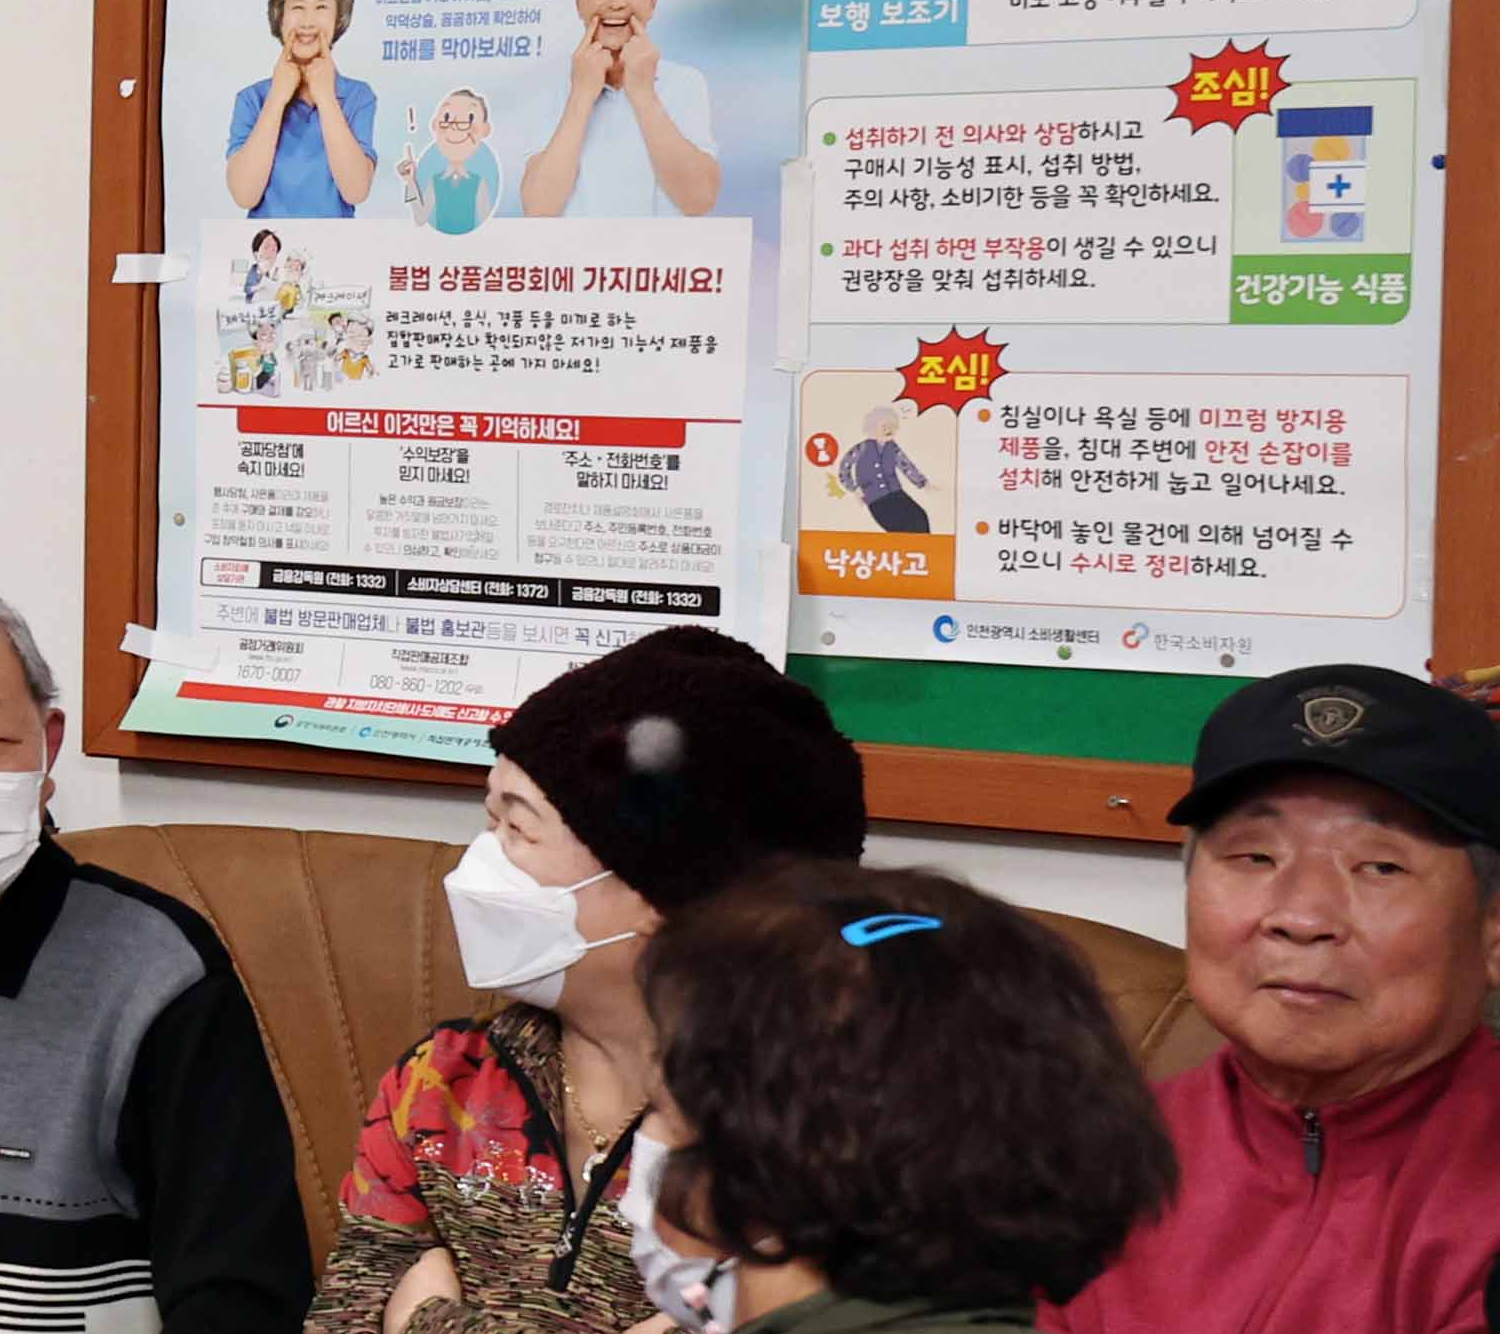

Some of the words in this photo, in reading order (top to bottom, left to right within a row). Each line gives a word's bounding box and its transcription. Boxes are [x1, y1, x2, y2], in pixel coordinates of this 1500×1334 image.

[818, 1, 870, 31] 보행
[382, 39, 435, 61] 피해를
[1190, 67, 1269, 107] 조심!
[846, 127, 926, 150] 섭취하기
[936, 126, 953, 148] 전
[963, 124, 1026, 144] 의사와
[1035, 121, 1144, 146] 상담하시고
[844, 158, 904, 179] 구매시
[914, 156, 974, 180] 기능성
[984, 155, 1031, 175] 표시,
[1041, 154, 1082, 177] 섭취
[1092, 153, 1140, 176] 방법,
[844, 189, 882, 210] 주의
[890, 188, 934, 211] 사항,
[941, 186, 1024, 209] 소비기한
[1030, 185, 1071, 209] 등을
[1078, 185, 1098, 207] 꼭
[1105, 183, 1219, 207] 확인하세요.
[843, 239, 882, 258] 과다
[890, 238, 928, 261] 섭취
[936, 237, 976, 261] 하면
[983, 237, 1066, 261] 부작용이
[1074, 237, 1115, 260] 생길
[1124, 237, 1144, 257] 수
[1152, 235, 1216, 259] 있으니
[390, 266, 430, 291] 불법
[439, 266, 573, 292] 상품설명회에
[584, 267, 722, 293] 가지마세요!
[842, 269, 924, 292] 권량장을
[932, 269, 973, 291] 맞춰
[983, 268, 1095, 291] 섭취하세요.
[1236, 274, 1343, 305] 건강기능
[1351, 273, 1407, 304] 식품
[916, 354, 989, 390] 조심!
[326, 411, 379, 438] 어르신
[385, 413, 455, 440] 이것만은
[460, 416, 478, 437] 꼭
[483, 416, 579, 440] 기억하세요!
[1001, 405, 1086, 429] 침실이나
[1094, 406, 1136, 430] 욕실
[1146, 408, 1190, 431] 등에
[1200, 409, 1266, 432] 미끄럼
[1277, 409, 1346, 434] 방지용
[1000, 437, 1068, 460] 제품을,
[1079, 438, 1120, 461] 침대
[1130, 439, 1195, 462] 주변에
[1205, 441, 1248, 464] 안전
[1259, 442, 1352, 467] 손잡이를
[999, 468, 1062, 491] 설치해
[1071, 470, 1158, 493] 안전하게
[1168, 472, 1212, 495] 눕고
[1221, 473, 1345, 496] 일어나세요.
[999, 519, 1062, 542] 바닥에
[1071, 521, 1113, 544] 놓인
[1122, 522, 1189, 546] 물건에
[1198, 525, 1242, 545] 의해
[1253, 526, 1320, 551] 넘어질
[1331, 529, 1353, 550] 수
[824, 549, 928, 579] 낙상사고
[998, 550, 1060, 572] 있으니
[1070, 553, 1136, 573] 수시로
[1146, 555, 1266, 578] 정리하세요.
[356, 574, 386, 588] 1332)
[967, 624, 1024, 639] 인천광역시
[1154, 635, 1253, 655] 한국소비자원
